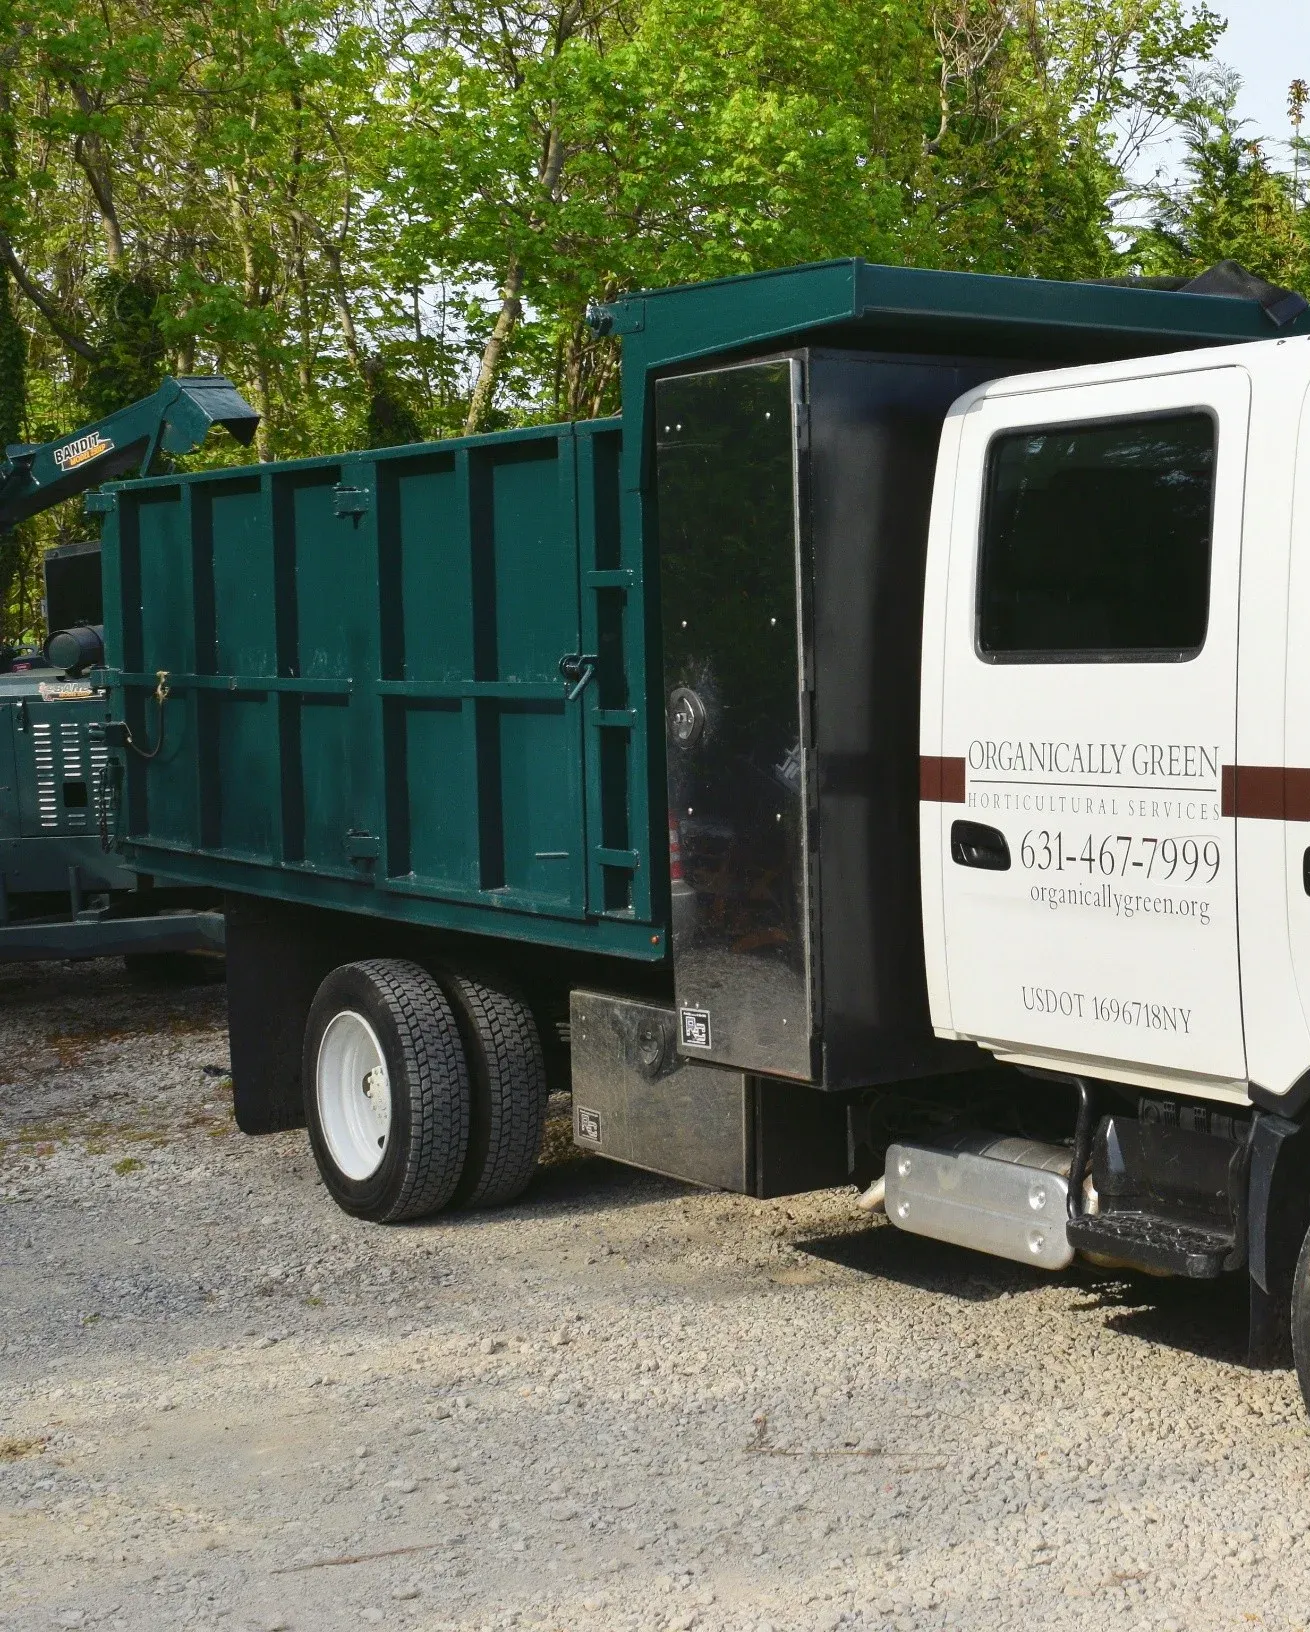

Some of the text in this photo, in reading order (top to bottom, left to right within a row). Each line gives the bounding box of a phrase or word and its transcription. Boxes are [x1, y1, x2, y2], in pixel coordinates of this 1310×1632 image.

[54, 432, 99, 464] BANDIT
[968, 740, 1220, 777] ORGANICALLY GREEN
[968, 792, 1220, 821] HORTICULTURAL SERVICES
[1021, 830, 1221, 884] 631-467-7999
[1030, 883, 1211, 925] organicallygreen.org
[1022, 986, 1192, 1034] USDOT 1696718NY
